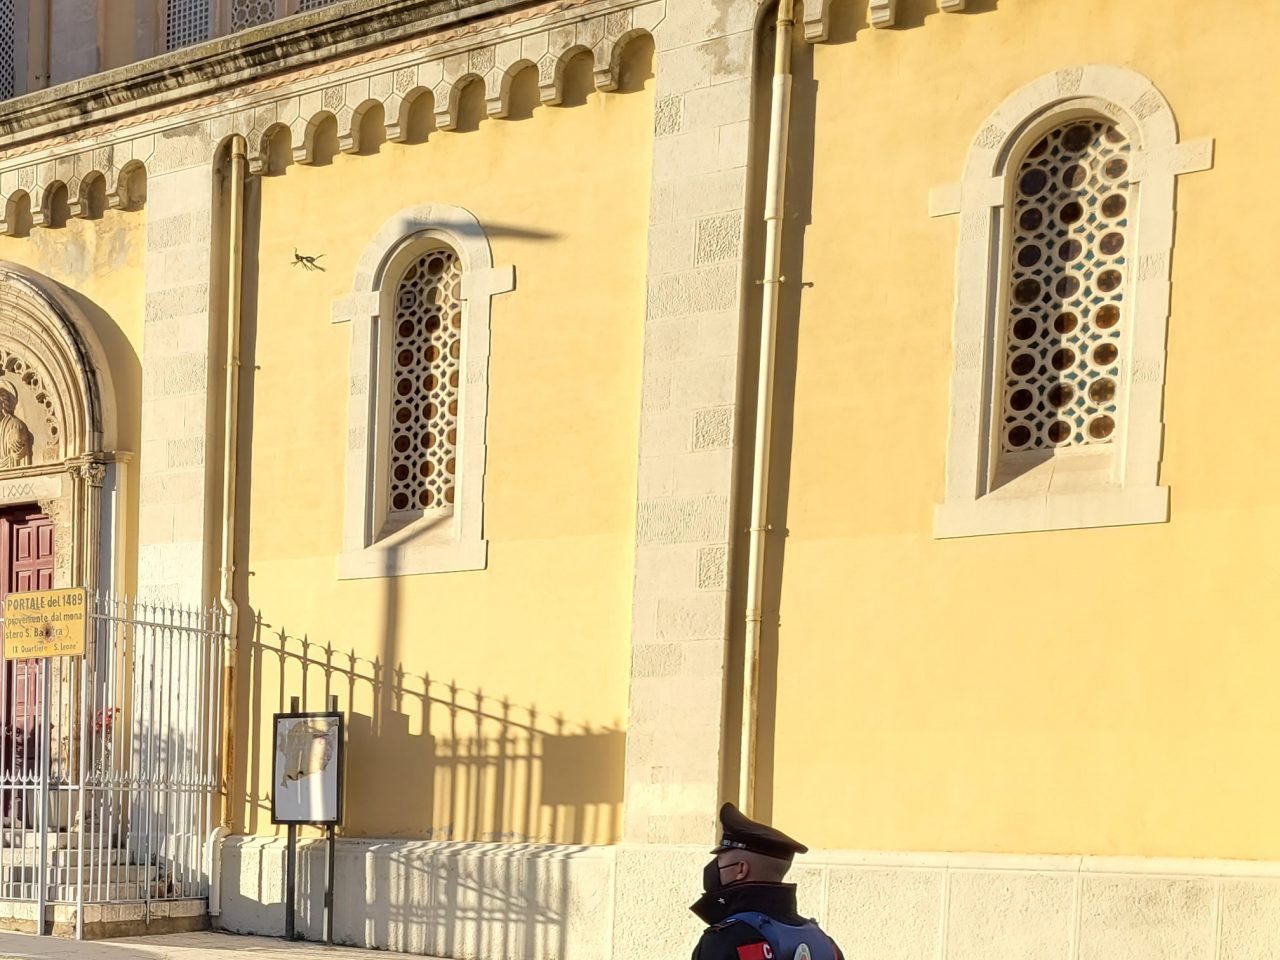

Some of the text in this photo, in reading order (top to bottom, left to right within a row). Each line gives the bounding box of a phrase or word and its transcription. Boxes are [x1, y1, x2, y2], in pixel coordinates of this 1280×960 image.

[8, 593, 83, 611] PORTALE del 1489
[50, 612, 62, 622] dal
[5, 629, 24, 640] stero
[25, 628, 32, 638] S.
[33, 627, 63, 638] Bara
